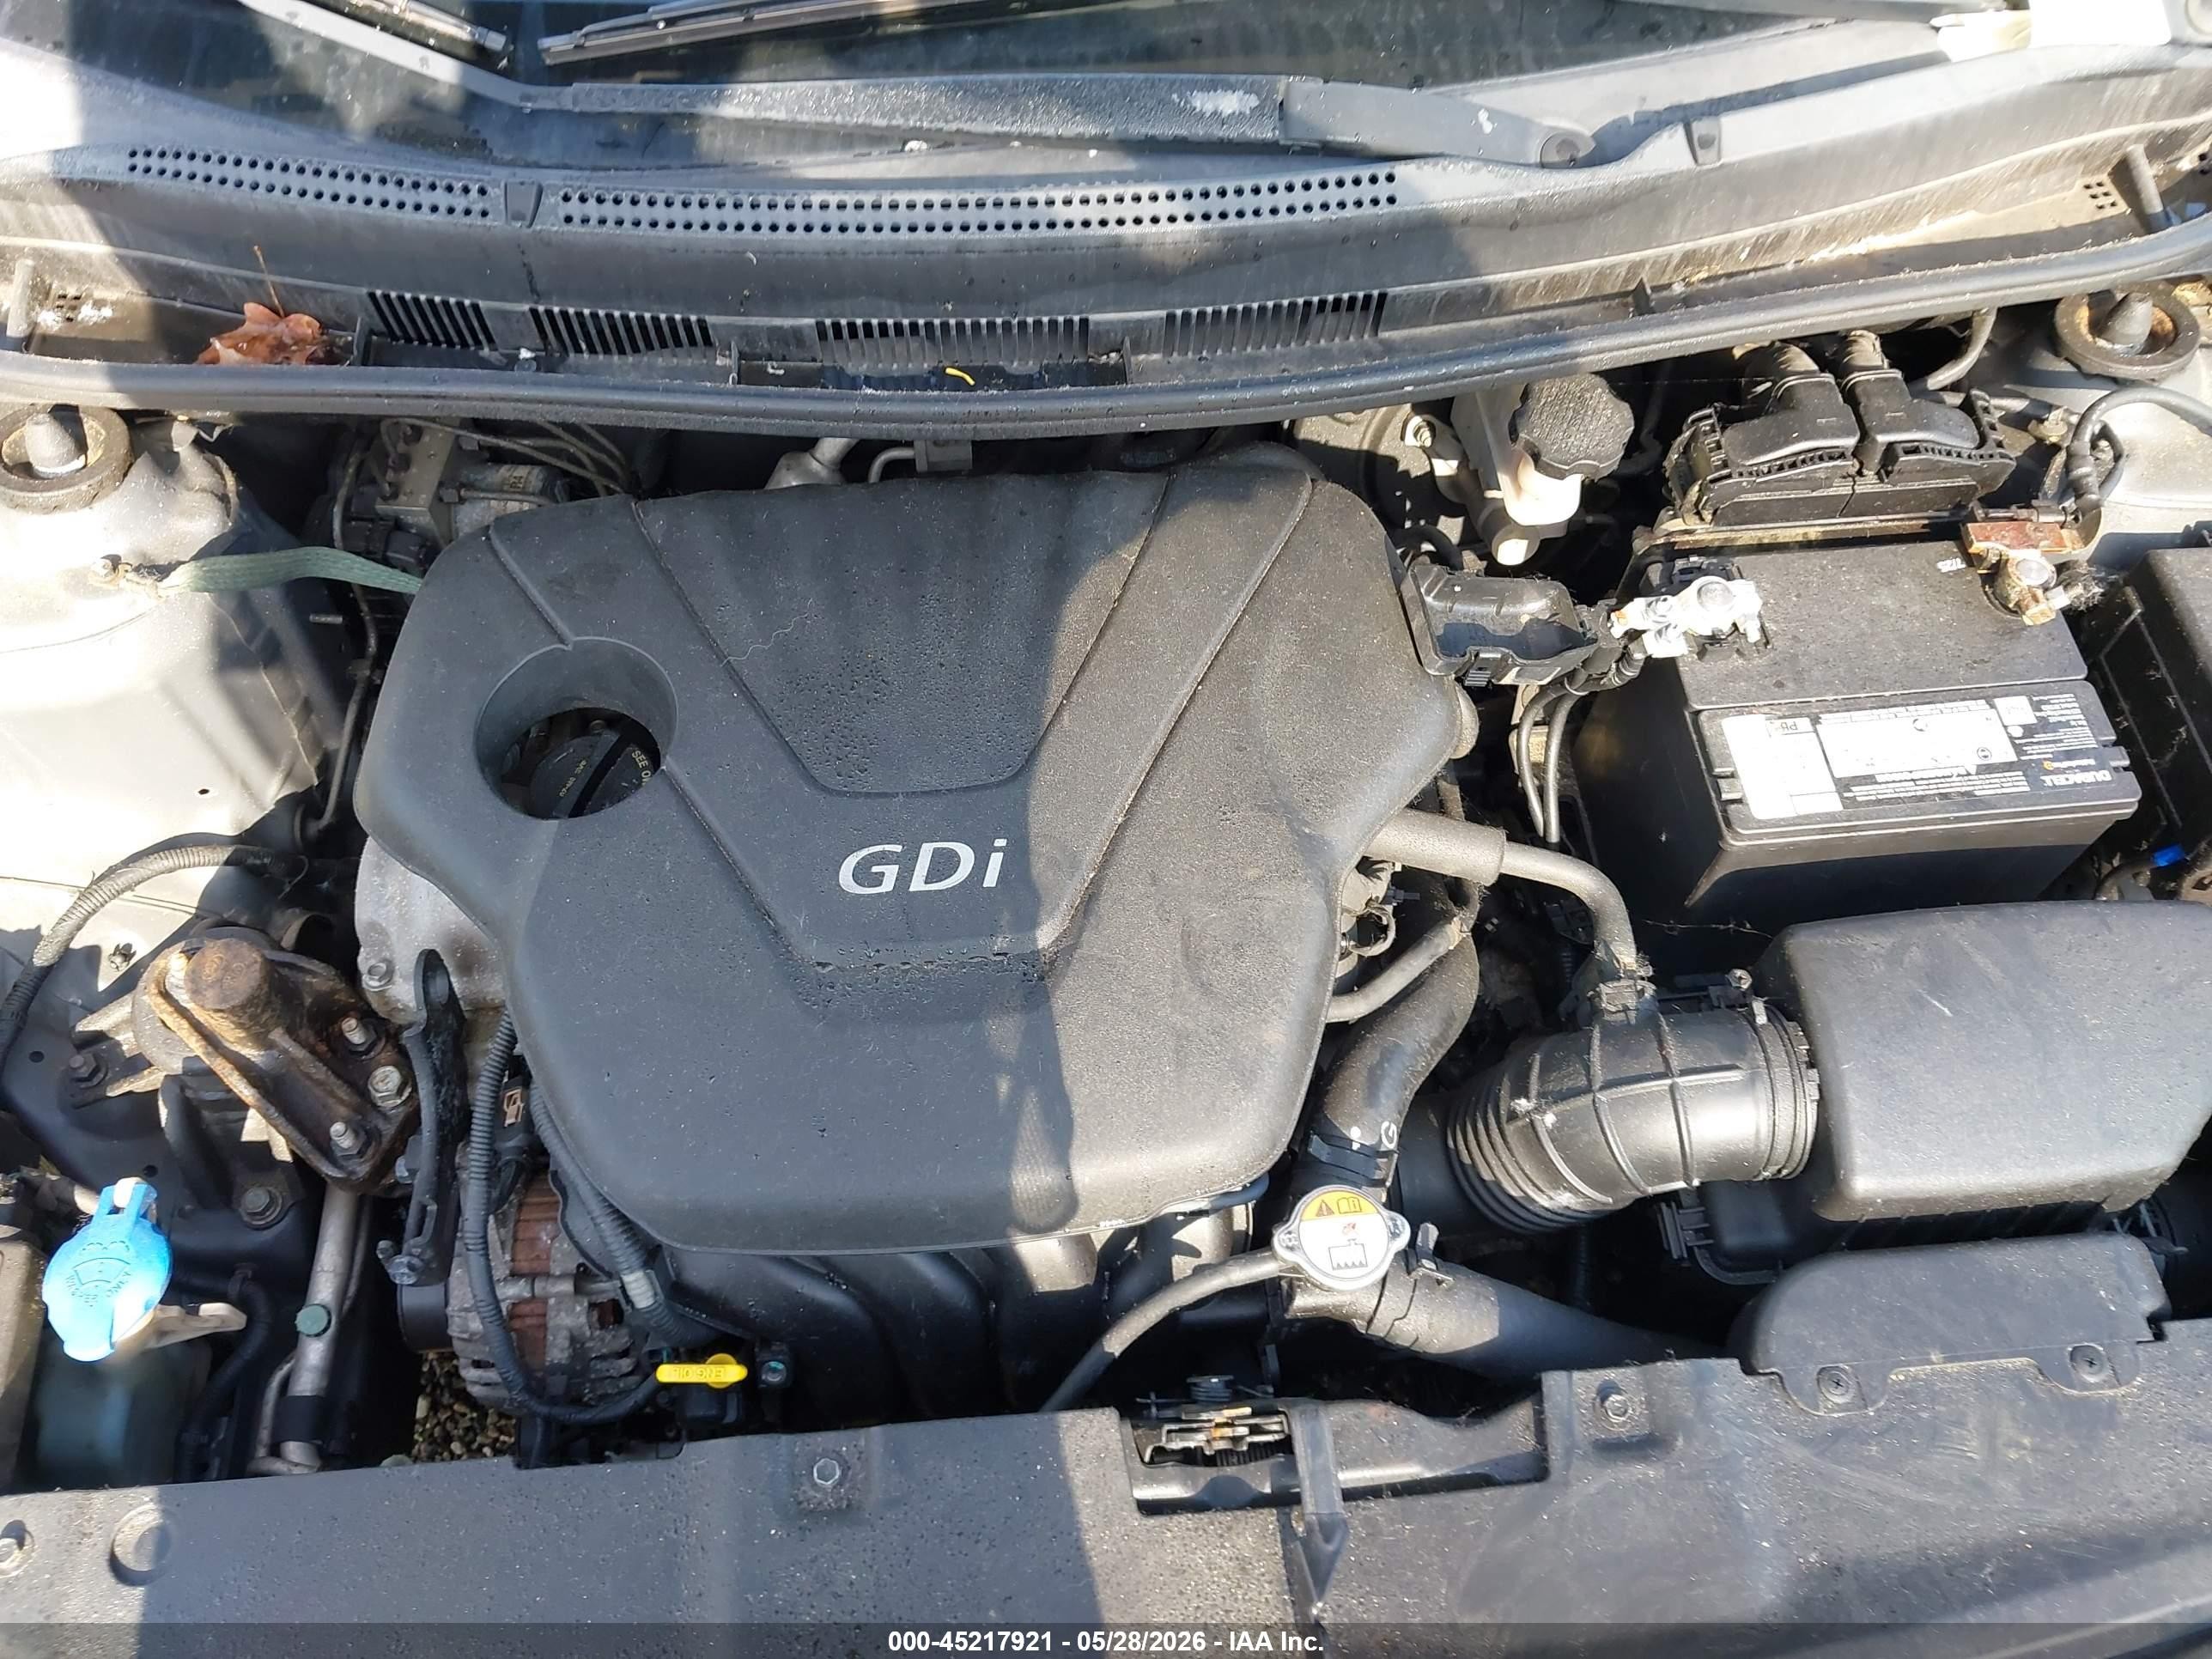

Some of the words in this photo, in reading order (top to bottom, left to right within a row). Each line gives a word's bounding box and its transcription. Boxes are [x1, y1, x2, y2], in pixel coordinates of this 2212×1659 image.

[632, 750, 649, 769] SEE
[2040, 769, 2112, 787] DURACELL
[838, 838, 1007, 895] GDi
[672, 1365, 692, 1380] OIL
[696, 1365, 726, 1379] ENG
